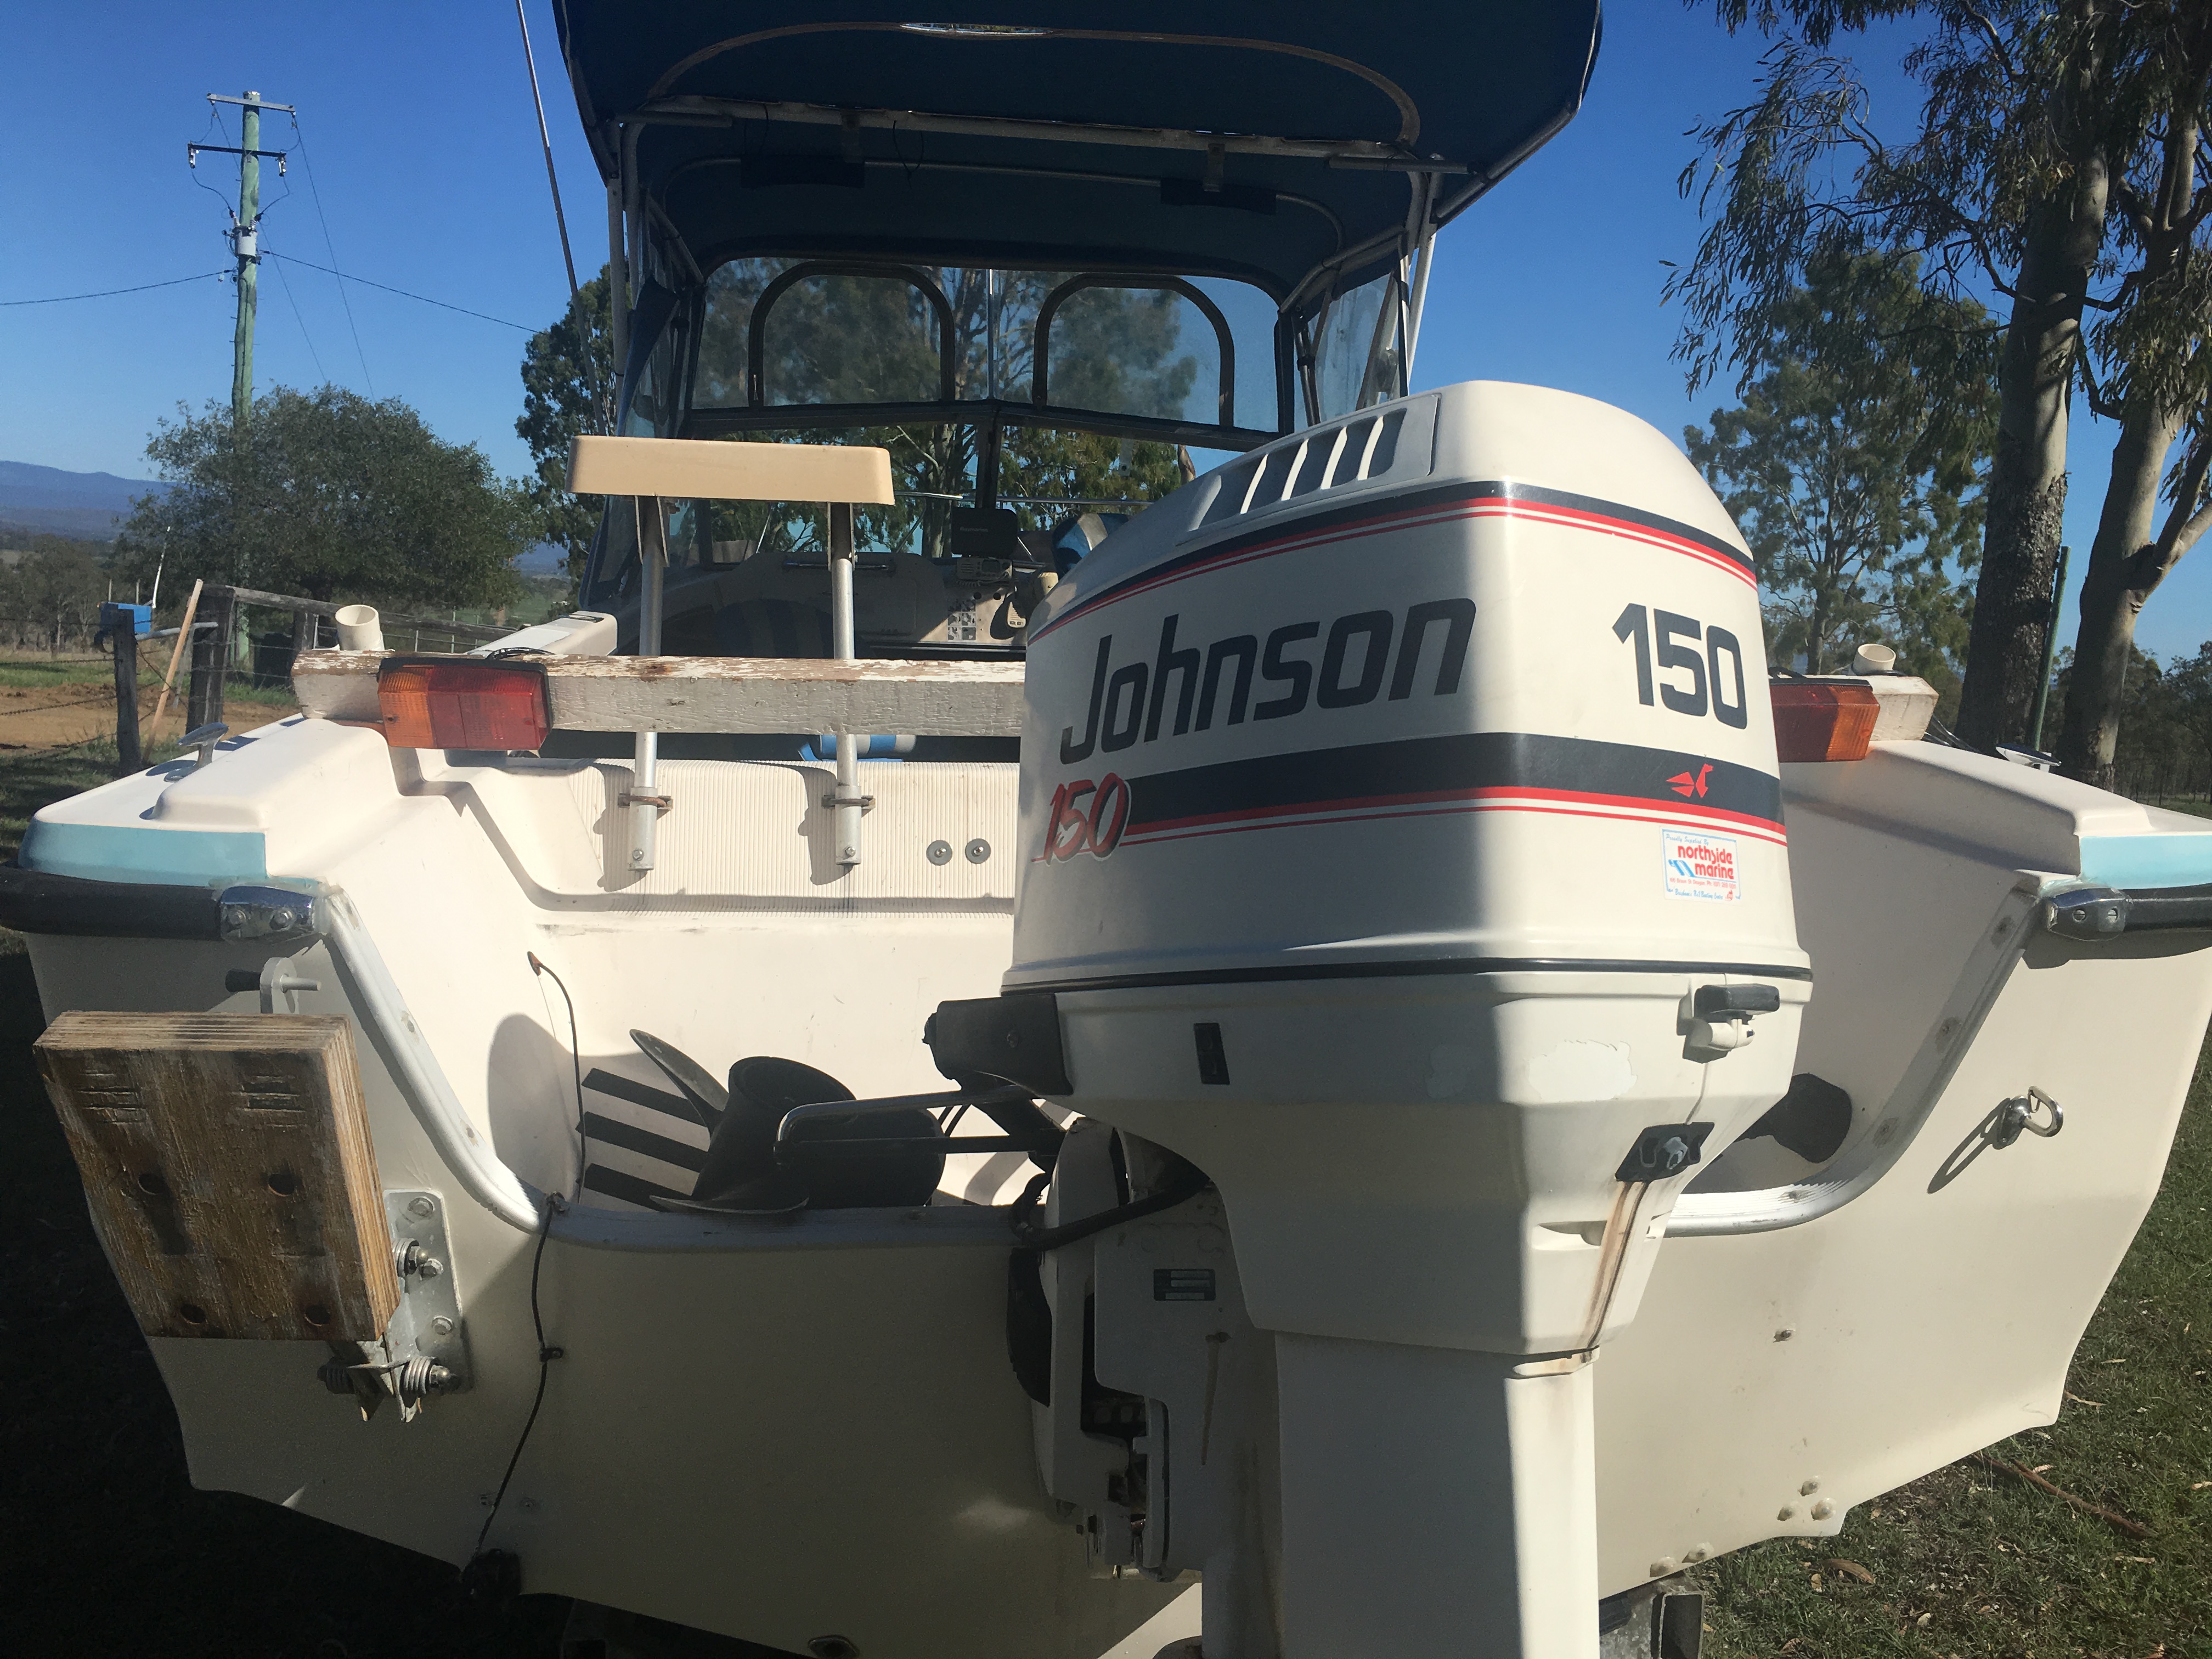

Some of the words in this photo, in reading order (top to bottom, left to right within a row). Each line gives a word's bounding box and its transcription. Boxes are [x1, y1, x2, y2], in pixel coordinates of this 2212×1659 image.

[1059, 598, 1476, 764] Johnson
[1612, 602, 1748, 730] 150
[1040, 772, 1131, 866] 150
[1678, 845, 1733, 865] northside
[1695, 864, 1734, 879] marine
